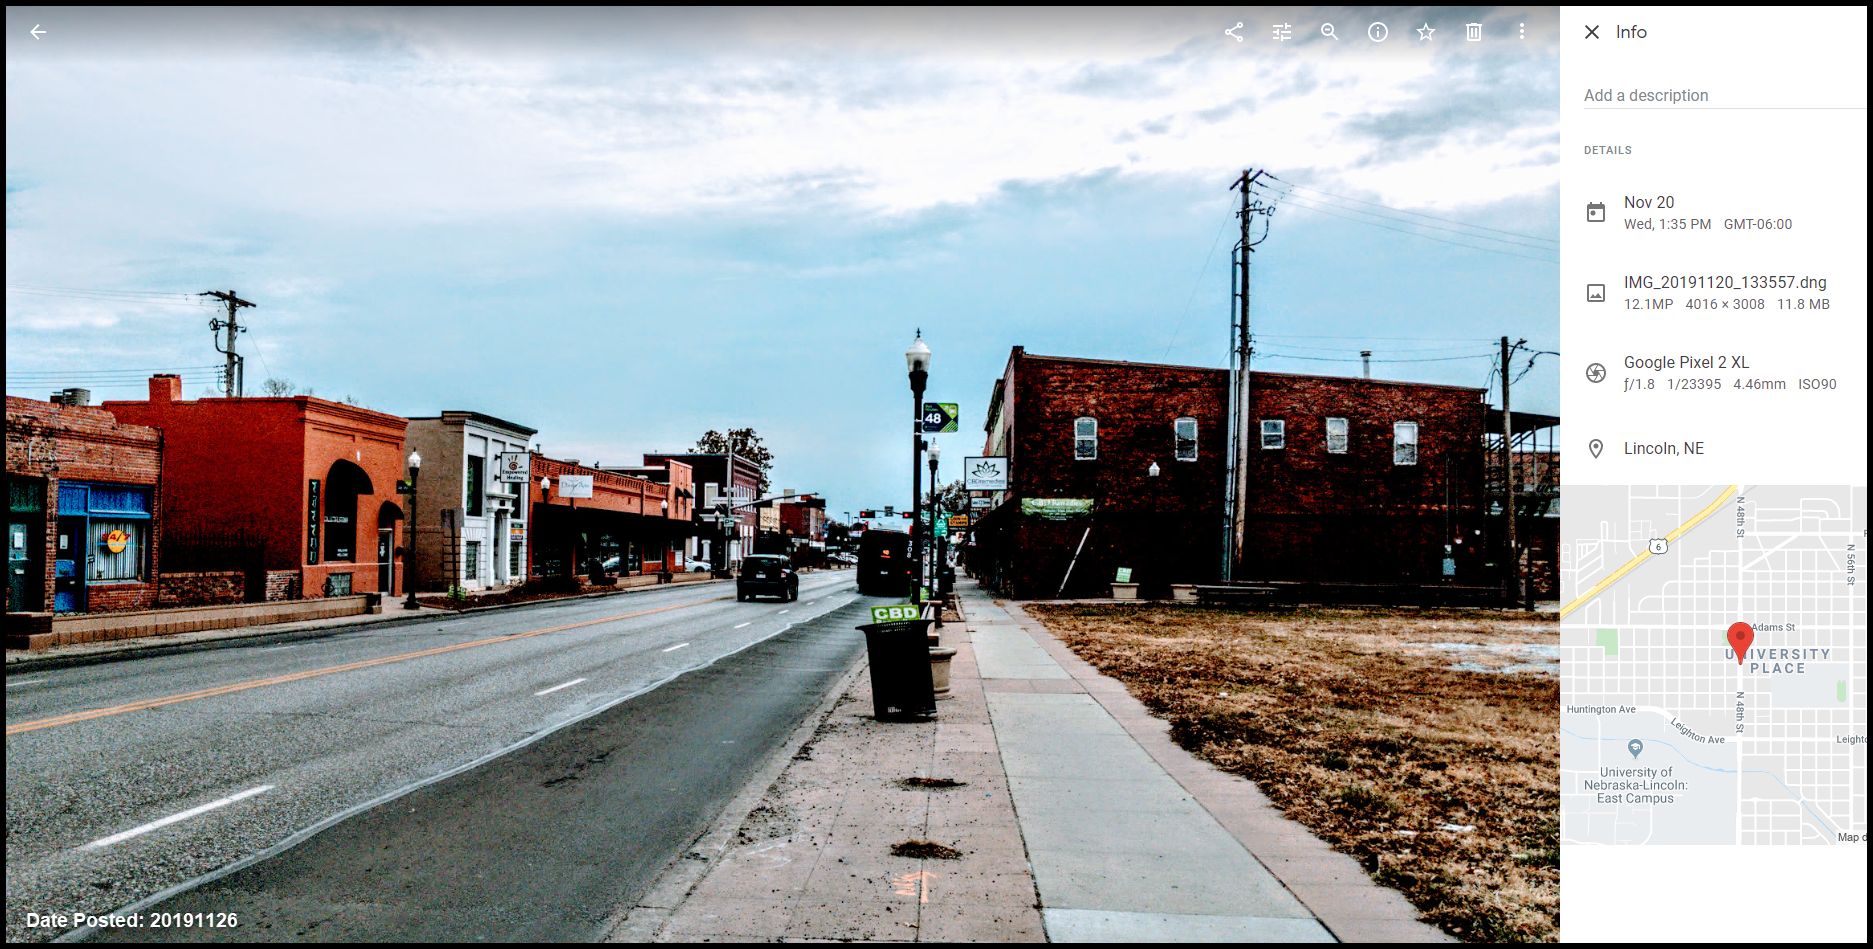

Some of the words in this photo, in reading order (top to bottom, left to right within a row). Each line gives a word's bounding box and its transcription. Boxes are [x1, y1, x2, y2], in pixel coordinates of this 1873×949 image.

[1616, 24, 1648, 39] Info
[1584, 88, 1612, 102] Add
[1616, 91, 1626, 102] a
[1629, 88, 1709, 105] description
[1584, 145, 1632, 155] DETAILS
[1624, 195, 1653, 209] Nov
[1657, 195, 1675, 209] 20
[1624, 218, 1655, 232] Wed,
[1659, 218, 1687, 230] 1:35
[1690, 218, 1712, 230] PM
[1724, 218, 1793, 230] GMT-06:00
[1624, 275, 1827, 292] IMG_20191120_133557.dng
[1624, 298, 1674, 310] 12.1MP
[1685, 298, 1718, 310] 4016
[1732, 298, 1765, 310] 3008
[1777, 298, 1805, 310] 11.8
[1809, 298, 1830, 310] MB
[1624, 355, 1676, 372] Google
[1680, 355, 1714, 369] Pixel
[1718, 355, 1727, 369] 2
[1731, 355, 1750, 369] XL
[1667, 378, 1722, 391] 1/23395
[1733, 378, 1786, 390] 4.46mm
[1798, 378, 1837, 390] ISO90
[924, 412, 942, 424] 48
[1624, 441, 1680, 457] Lincoln,
[1684, 441, 1705, 455] NE
[1736, 496, 1745, 504] N
[1736, 505, 1745, 526] 48th
[1736, 528, 1745, 538] St
[1656, 543, 1662, 551] 6
[1847, 544, 1856, 552] N
[1847, 554, 1856, 574] 56th
[1847, 575, 1856, 586] St
[874, 606, 917, 619] CBD
[1752, 622, 1784, 632] Adams
[1786, 623, 1795, 632] St
[1725, 648, 1830, 660] UIVERSITY
[1750, 662, 1805, 674] PLACE
[1736, 691, 1745, 699] N
[1566, 704, 1617, 716] Huntington
[1618, 704, 1636, 714] Ave
[1736, 700, 1745, 721] 48th
[1670, 717, 1706, 745] Leighton
[1707, 734, 1726, 745] Ave
[1736, 722, 1745, 733] St
[1599, 766, 1659, 780] University
[1660, 766, 1673, 778] of
[1584, 779, 1689, 791] Nebraska-Lincoln:
[1597, 792, 1623, 804] East
[1625, 792, 1675, 806] Campus
[1838, 832, 1860, 844] Map
